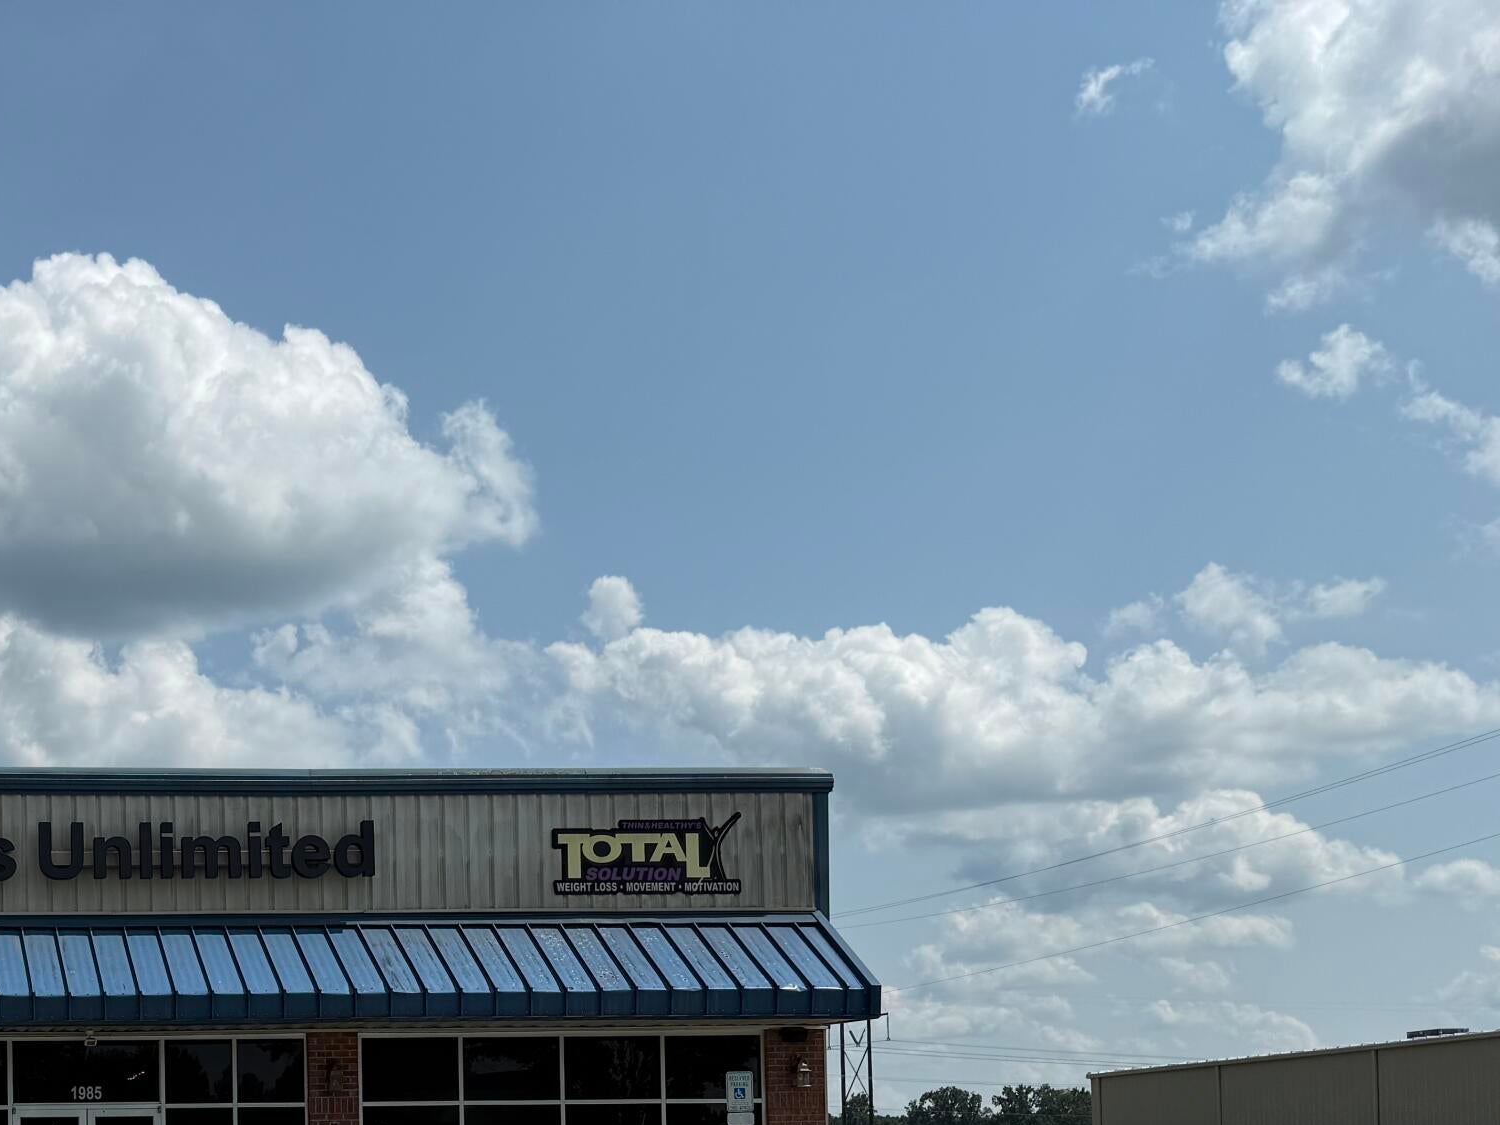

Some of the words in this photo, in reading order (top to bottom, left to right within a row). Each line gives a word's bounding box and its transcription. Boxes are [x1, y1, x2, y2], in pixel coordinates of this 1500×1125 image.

[37, 819, 376, 880] Unlimited
[557, 832, 711, 879] TOTAL
[585, 866, 683, 881] SOLUTION
[556, 881, 593, 892] WEIGHT
[594, 881, 618, 892] LOSS
[626, 881, 680, 892] MOVEMENT
[684, 881, 740, 892] MOTIVATION
[70, 1086, 102, 1100] 1985
